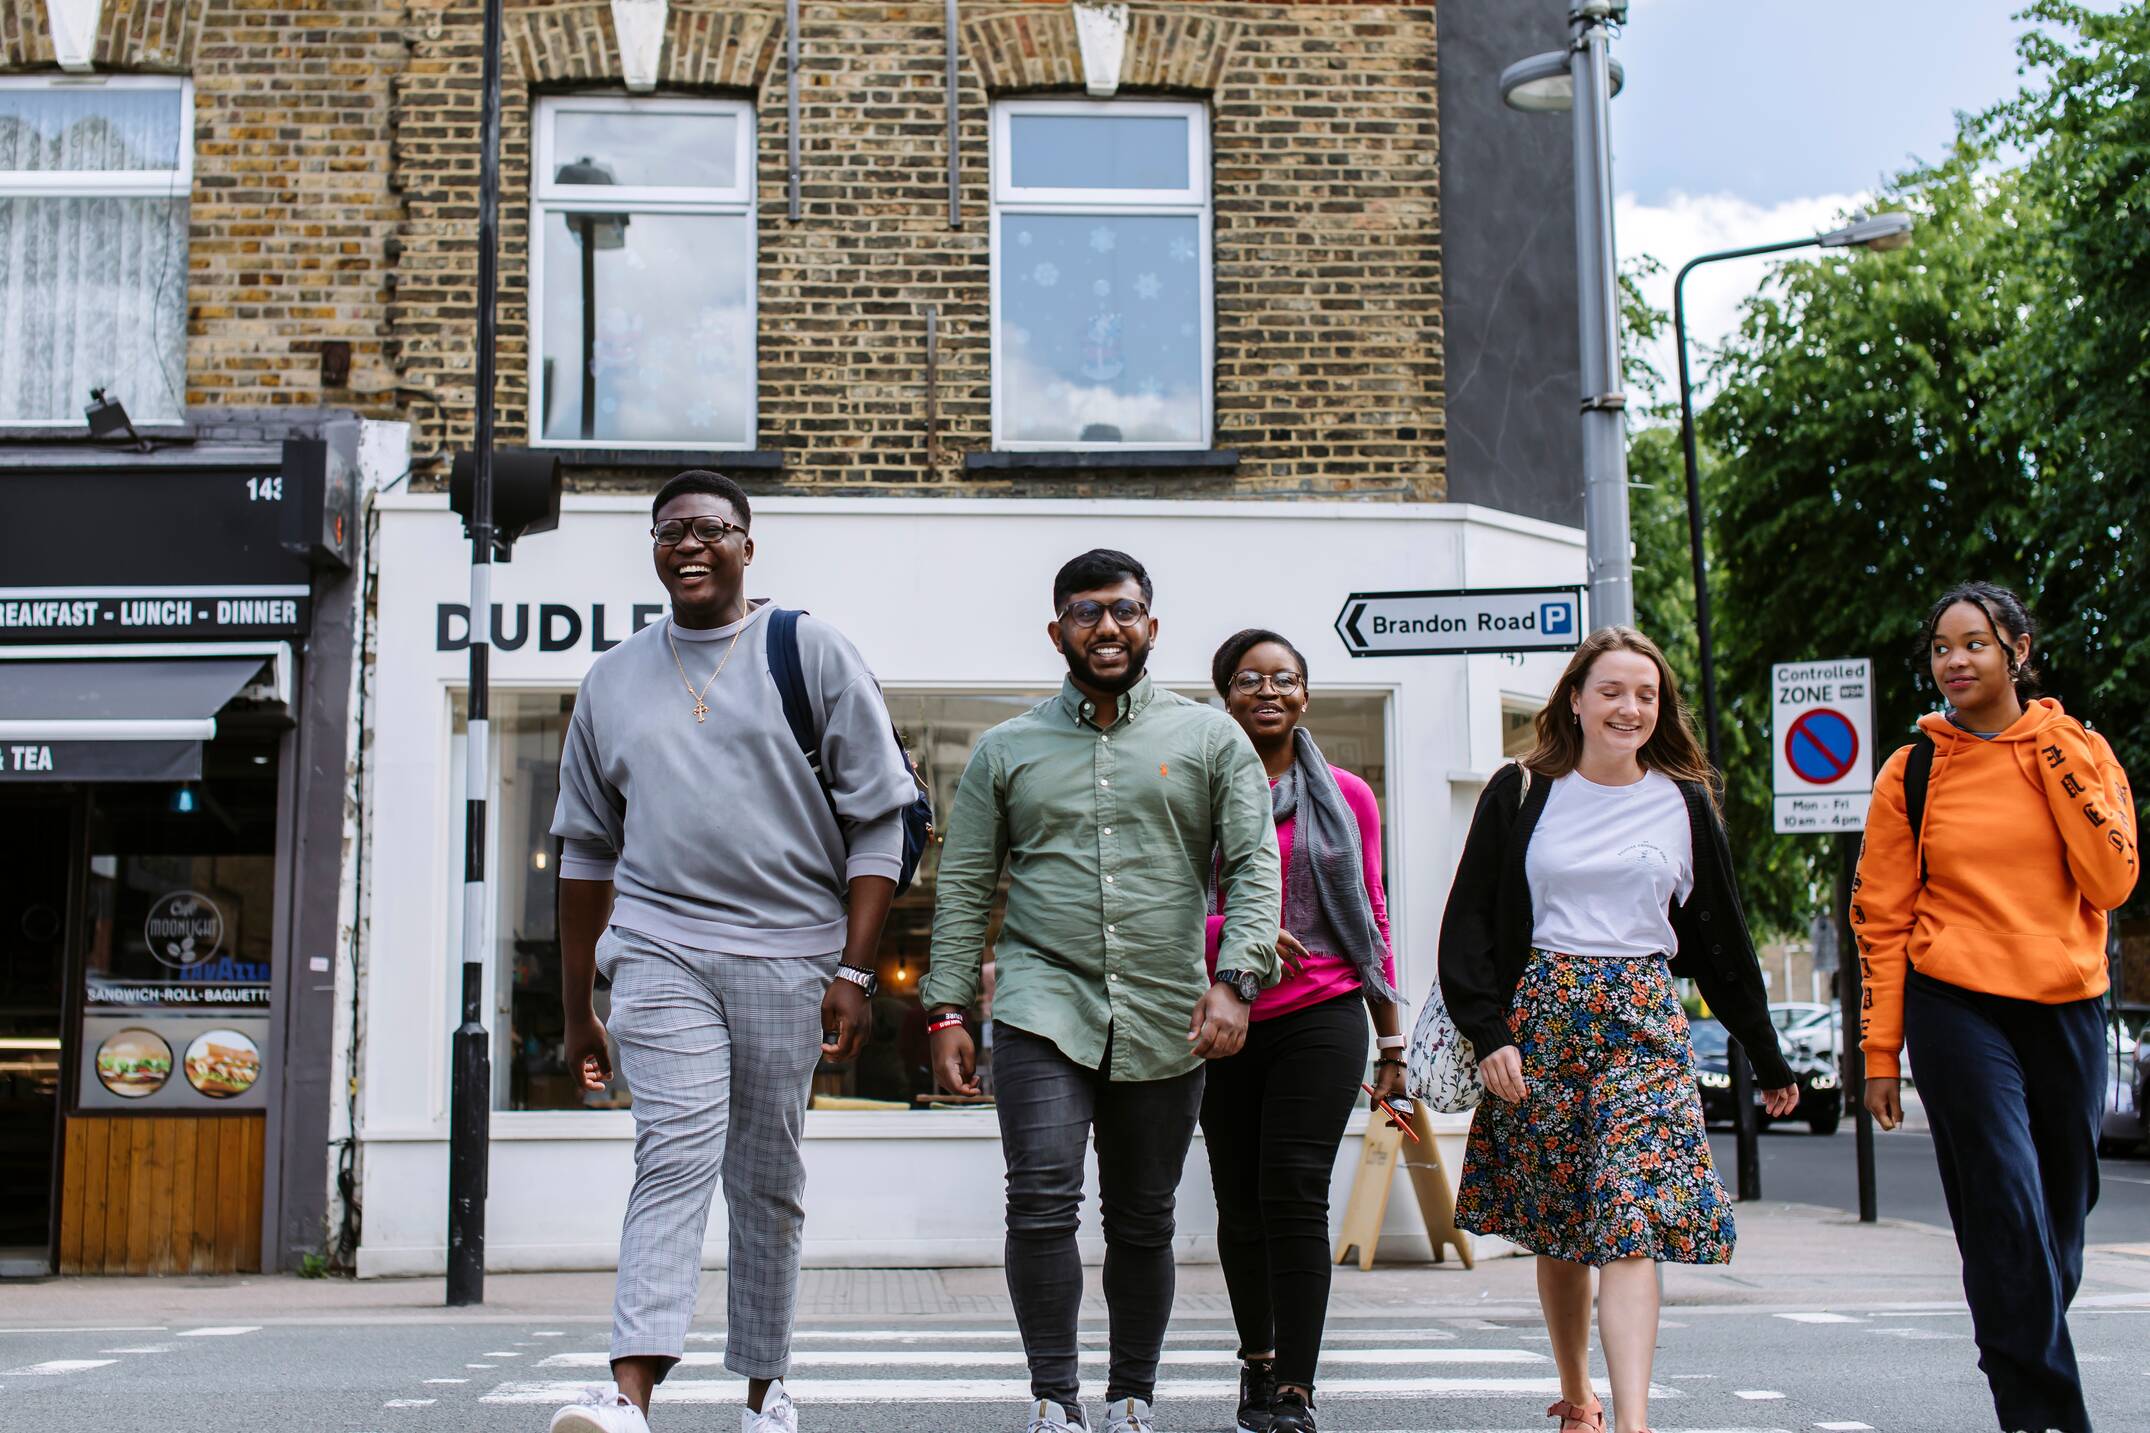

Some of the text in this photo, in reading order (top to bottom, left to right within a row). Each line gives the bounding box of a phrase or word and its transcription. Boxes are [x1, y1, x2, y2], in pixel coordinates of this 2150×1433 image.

[246, 477, 283, 501] 143
[120, 601, 192, 626] LUNCH
[217, 600, 296, 624] DINNER
[1373, 614, 1467, 634] Brandon
[1478, 612, 1535, 631] Road
[437, 603, 664, 652] DUDLE
[1778, 664, 1865, 682] Controlled
[1779, 685, 1833, 704] ZONE
[11, 745, 53, 771] TEA
[1793, 800, 1818, 811] Mon
[1834, 799, 1850, 810] Fri
[87, 988, 160, 1002] SANDWICH
[164, 988, 199, 1002] ROLL
